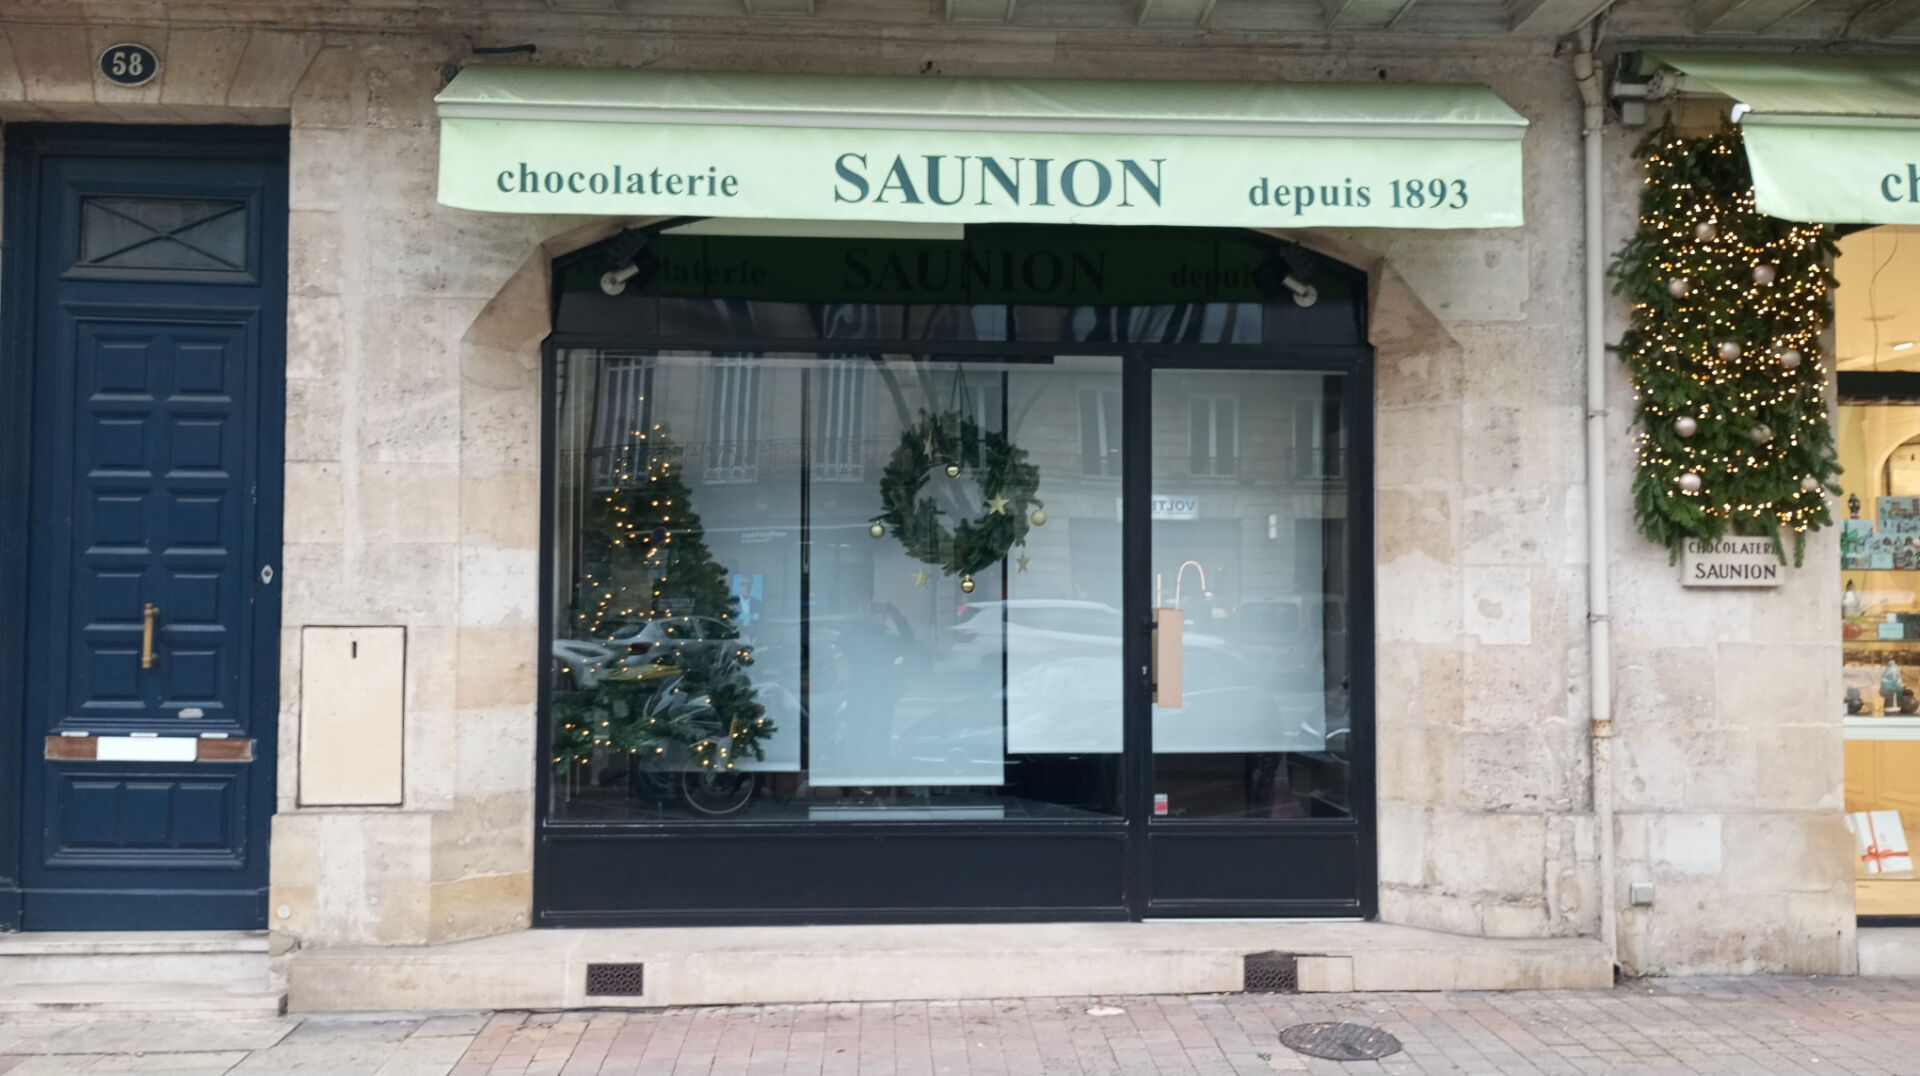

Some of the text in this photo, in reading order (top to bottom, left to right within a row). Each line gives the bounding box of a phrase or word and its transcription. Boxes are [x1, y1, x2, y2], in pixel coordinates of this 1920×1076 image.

[112, 52, 143, 76] 58
[497, 153, 1468, 216] chocolaterie SAUNION depuis 1893
[843, 247, 1108, 294] SAUNION
[1171, 262, 1256, 294] depui
[1688, 541, 1776, 554] CHOCOLATERI
[1695, 562, 1777, 580] SAUNION
